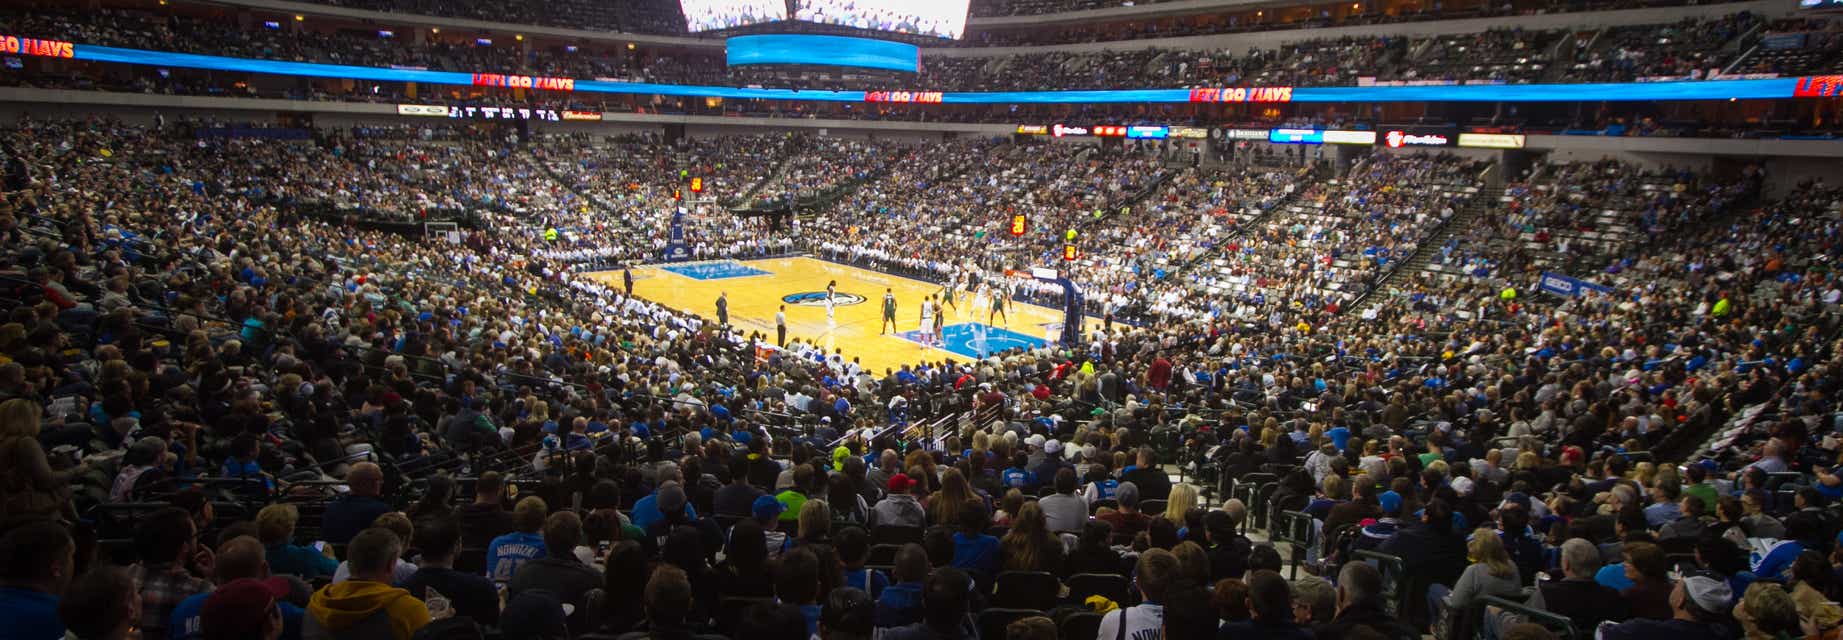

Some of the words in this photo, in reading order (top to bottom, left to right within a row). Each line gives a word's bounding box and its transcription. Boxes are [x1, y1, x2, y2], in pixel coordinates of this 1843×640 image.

[471, 72, 507, 86] LET'S
[509, 75, 534, 89] GO
[893, 91, 911, 103] GO
[1189, 88, 1223, 103] LET'S
[1224, 87, 1247, 103] GO
[1545, 277, 1573, 292] GEICO
[496, 543, 539, 559] NOWITZKI
